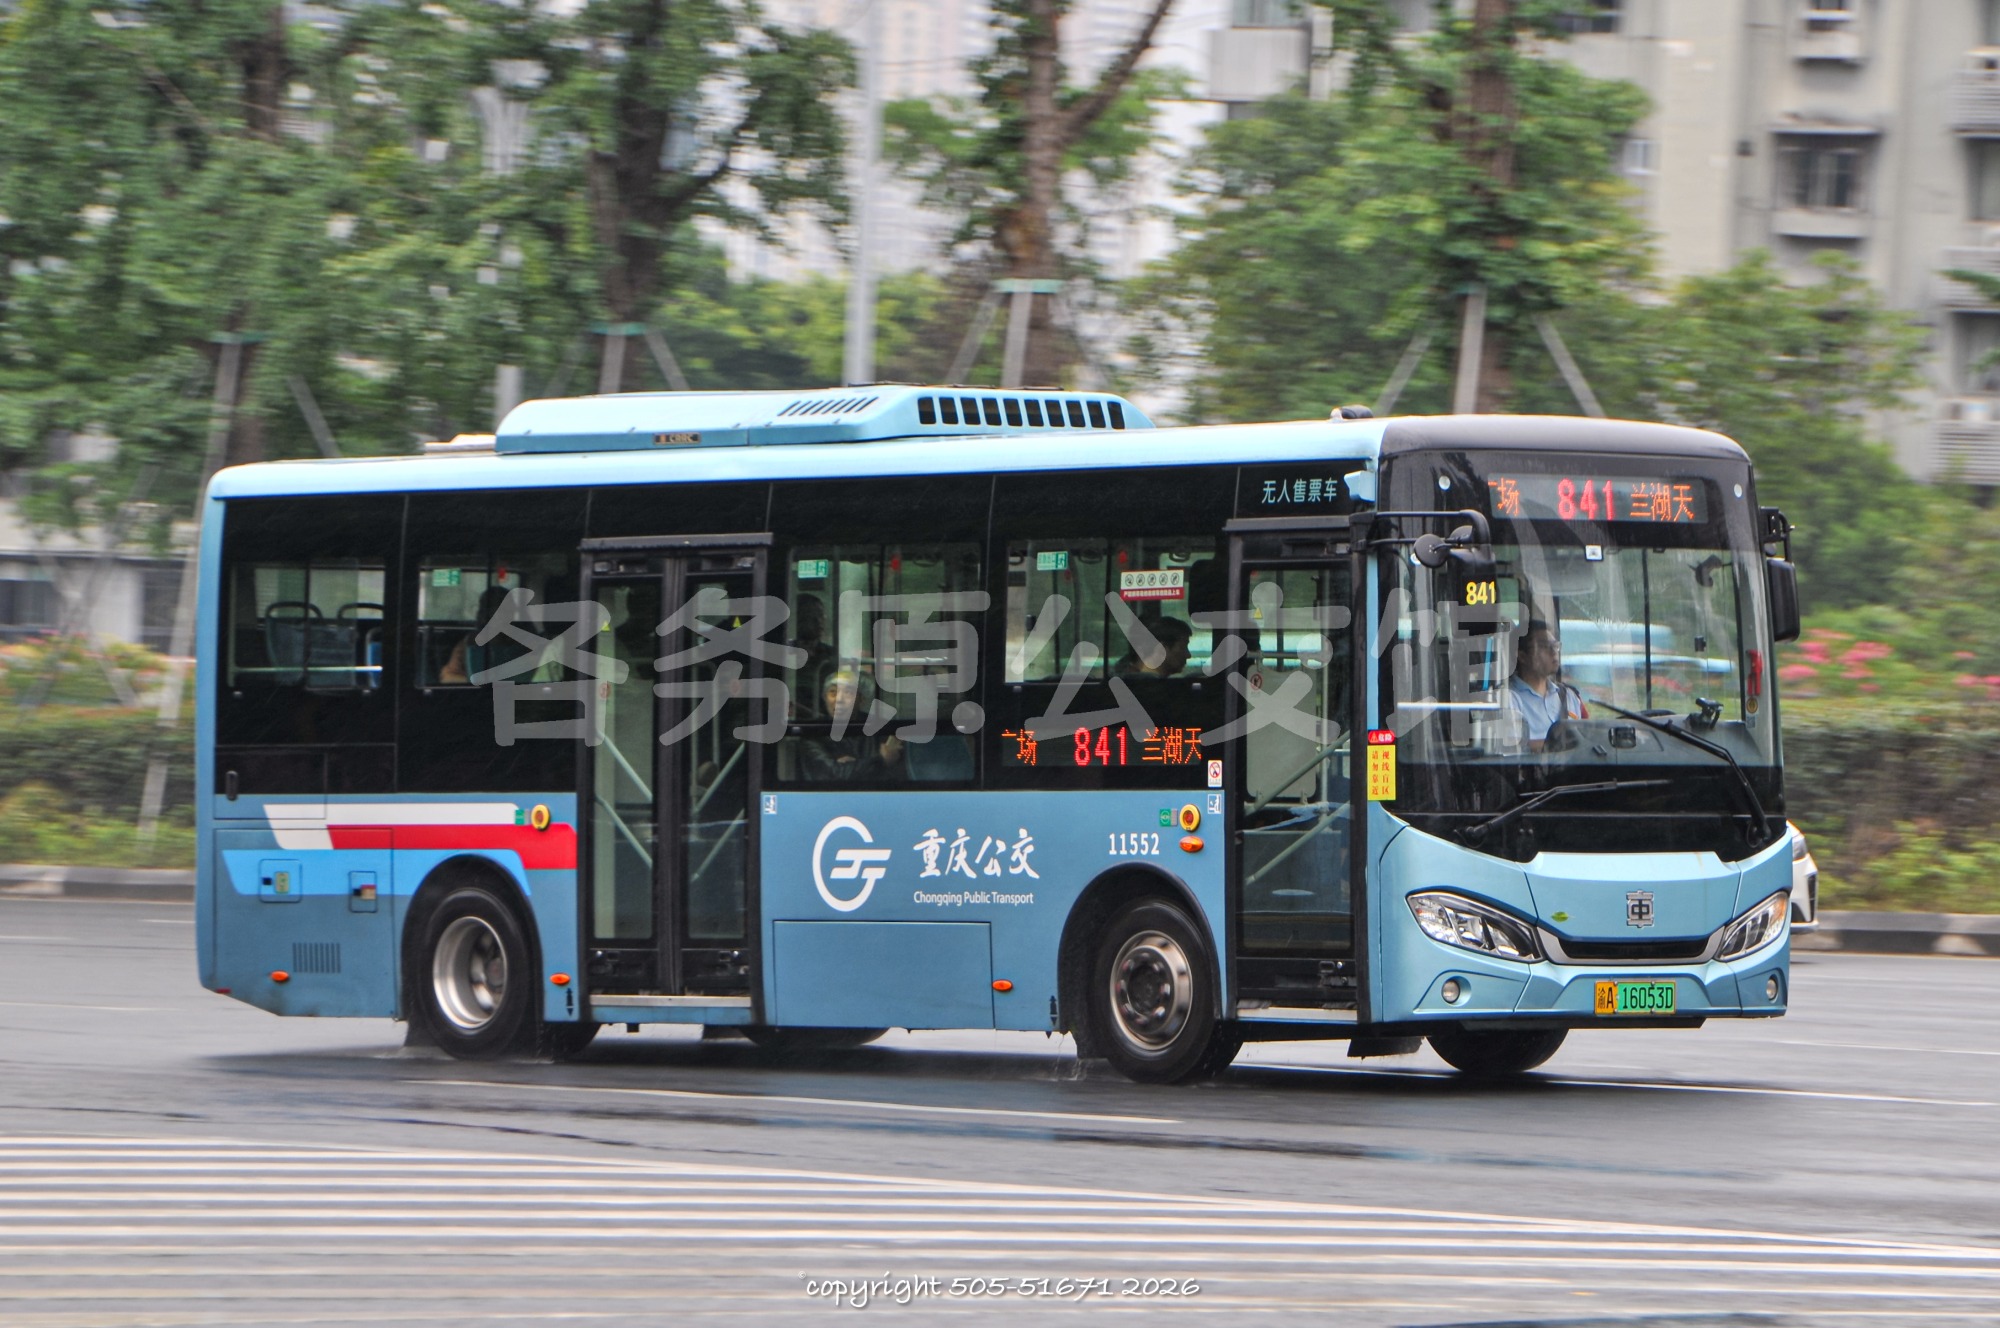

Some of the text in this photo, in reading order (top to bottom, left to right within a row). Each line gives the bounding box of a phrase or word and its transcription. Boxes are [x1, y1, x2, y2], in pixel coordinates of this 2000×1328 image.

[1261, 477, 1338, 504] 无人售票车
[1557, 478, 1615, 520] 841
[1630, 482, 1695, 521] 兰湖天
[1466, 581, 1496, 605] 841
[1074, 726, 1127, 766] 841
[1142, 726, 1201, 764] 兰湖天
[913, 828, 1040, 879] 重庆公交
[1108, 832, 1160, 855] 11552
[913, 891, 1034, 906] Chongqing Public Transport
